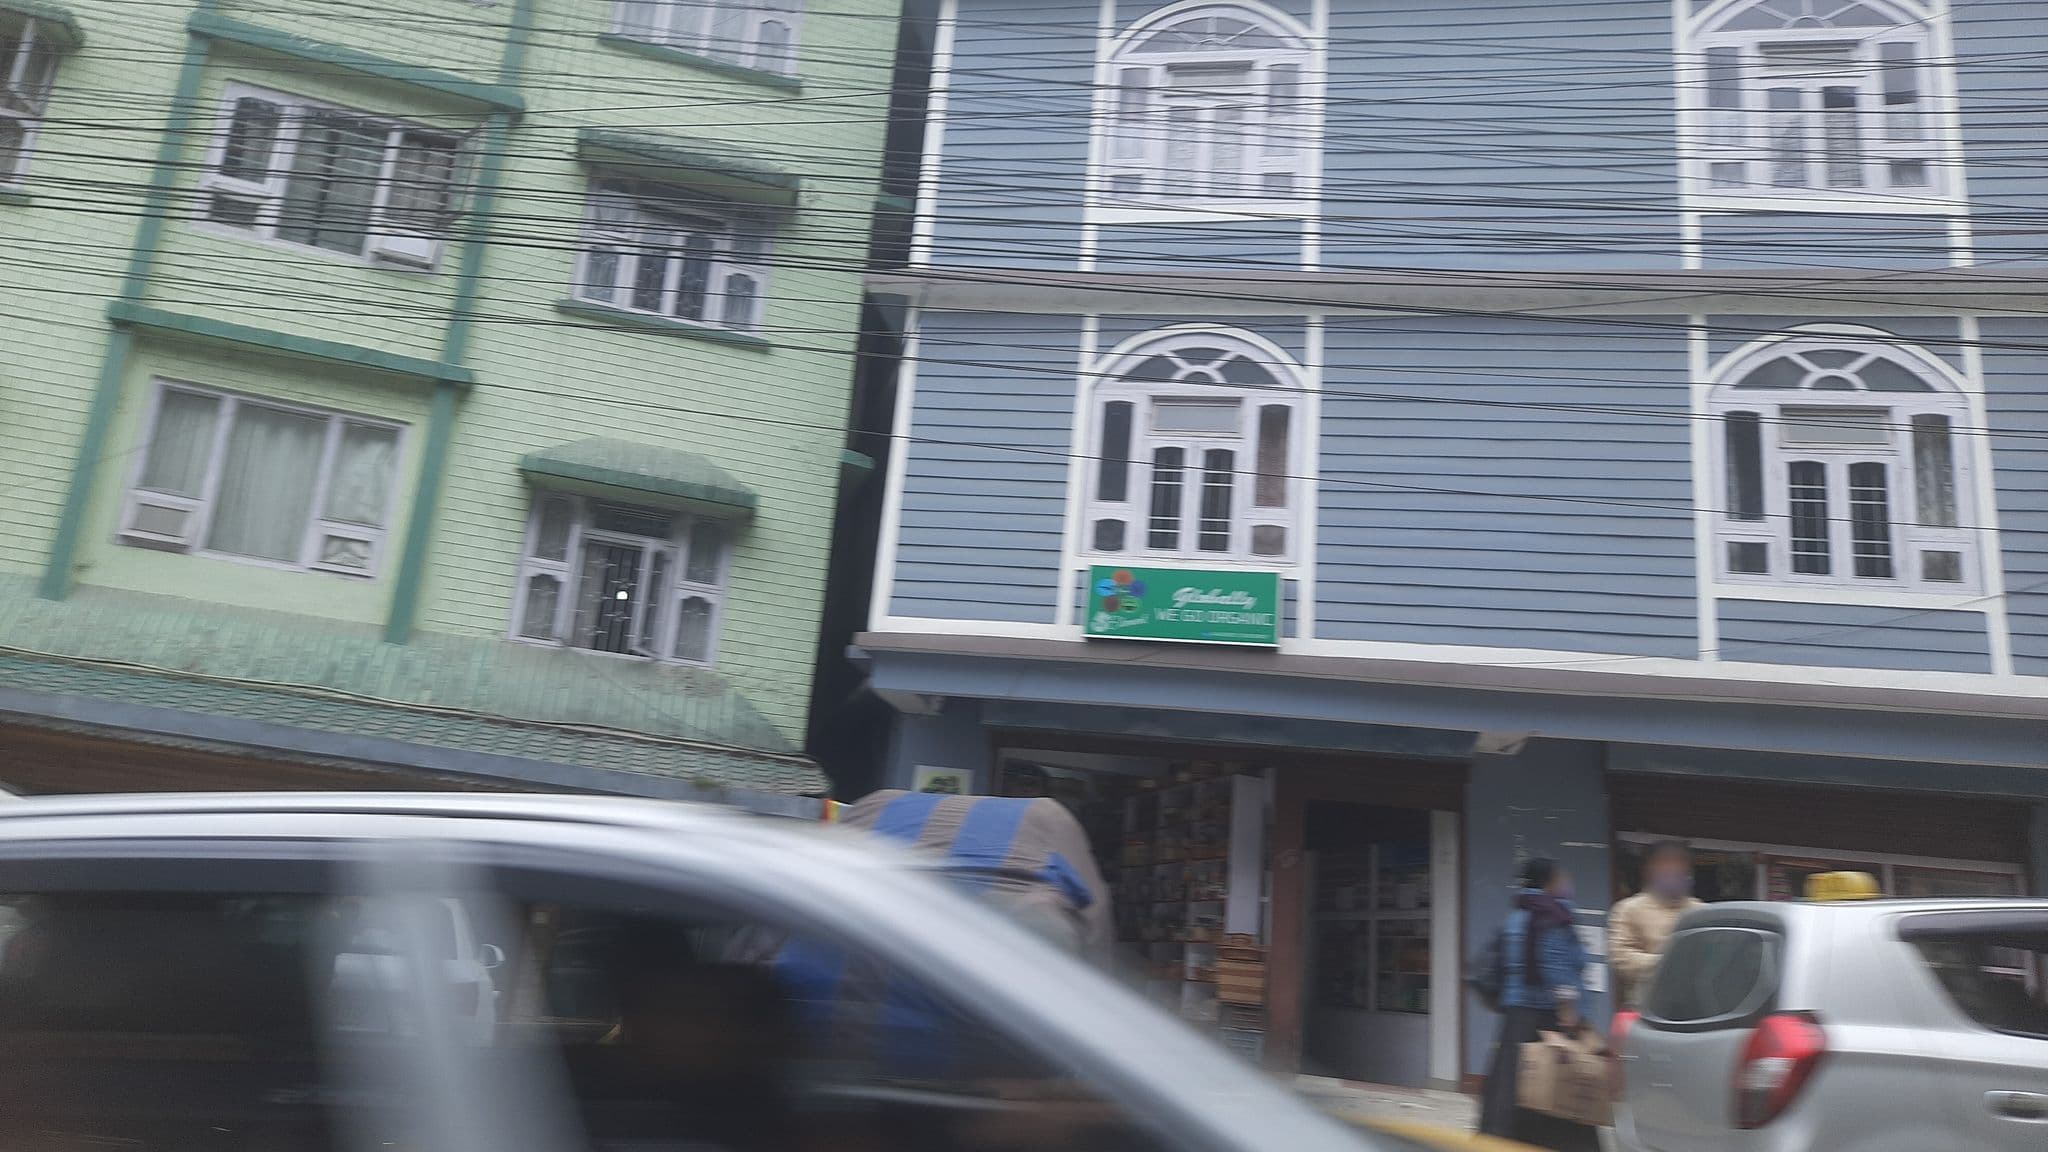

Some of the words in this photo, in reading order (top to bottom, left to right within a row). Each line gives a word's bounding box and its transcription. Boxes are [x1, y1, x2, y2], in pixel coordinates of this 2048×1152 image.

[1154, 608, 1180, 621] WE
[1181, 609, 1204, 622] GO
[1207, 610, 1275, 626] ORGANIC
